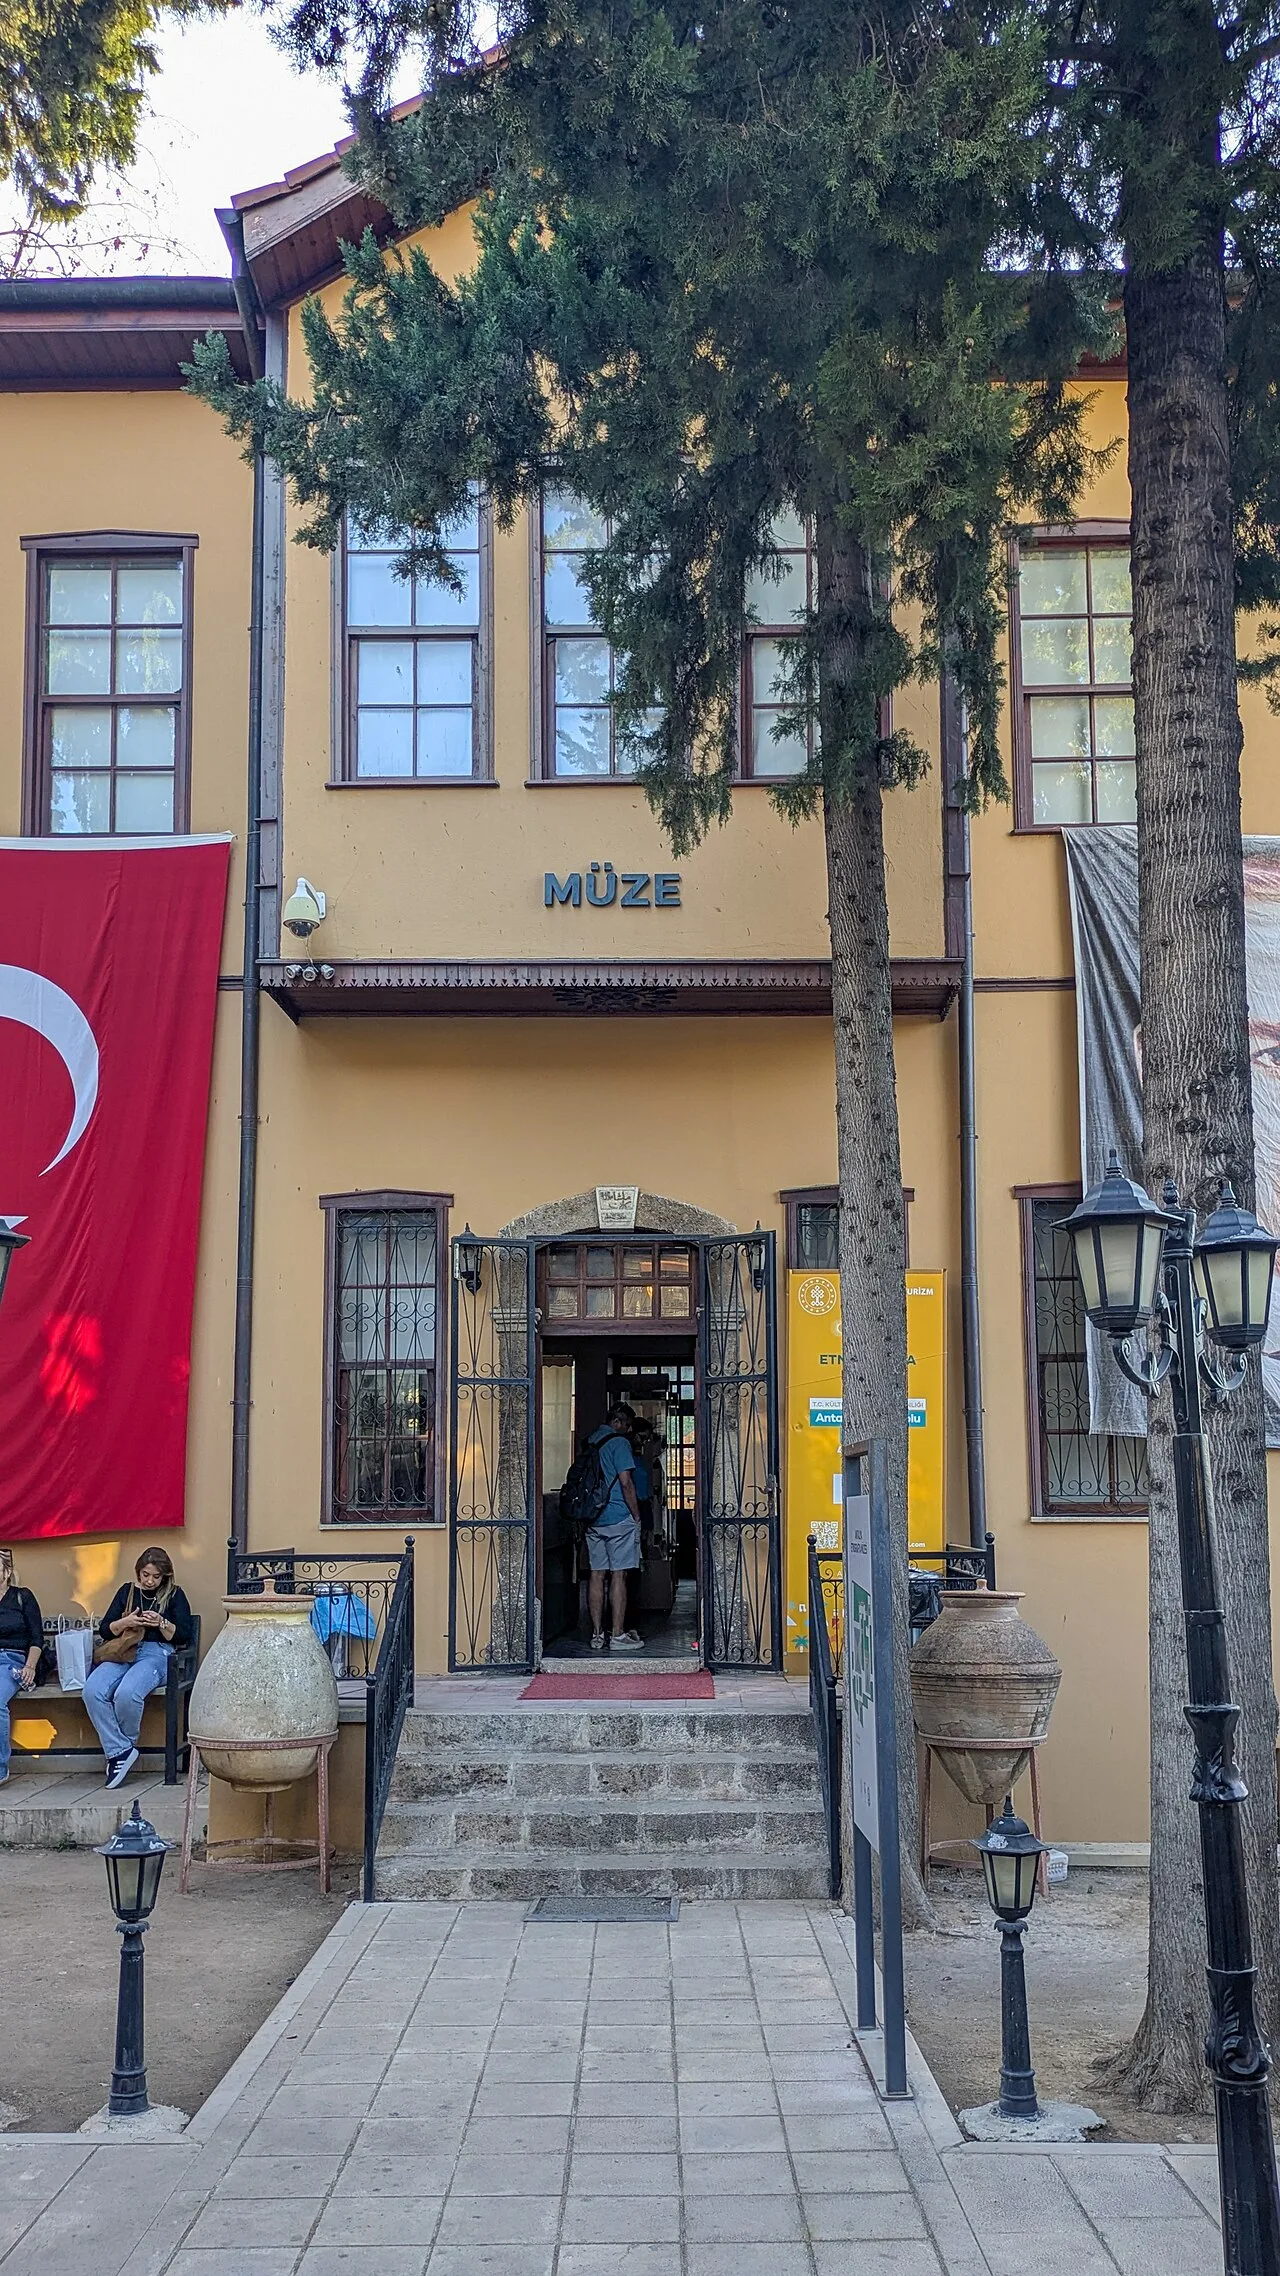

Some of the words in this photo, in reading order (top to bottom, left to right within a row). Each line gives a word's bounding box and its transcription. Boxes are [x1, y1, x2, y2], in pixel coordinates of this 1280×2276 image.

[544, 862, 681, 907] MÜZE
[907, 1287, 934, 1296] URİZM
[820, 1354, 844, 1365] ETN
[815, 1412, 843, 1423] Anta
